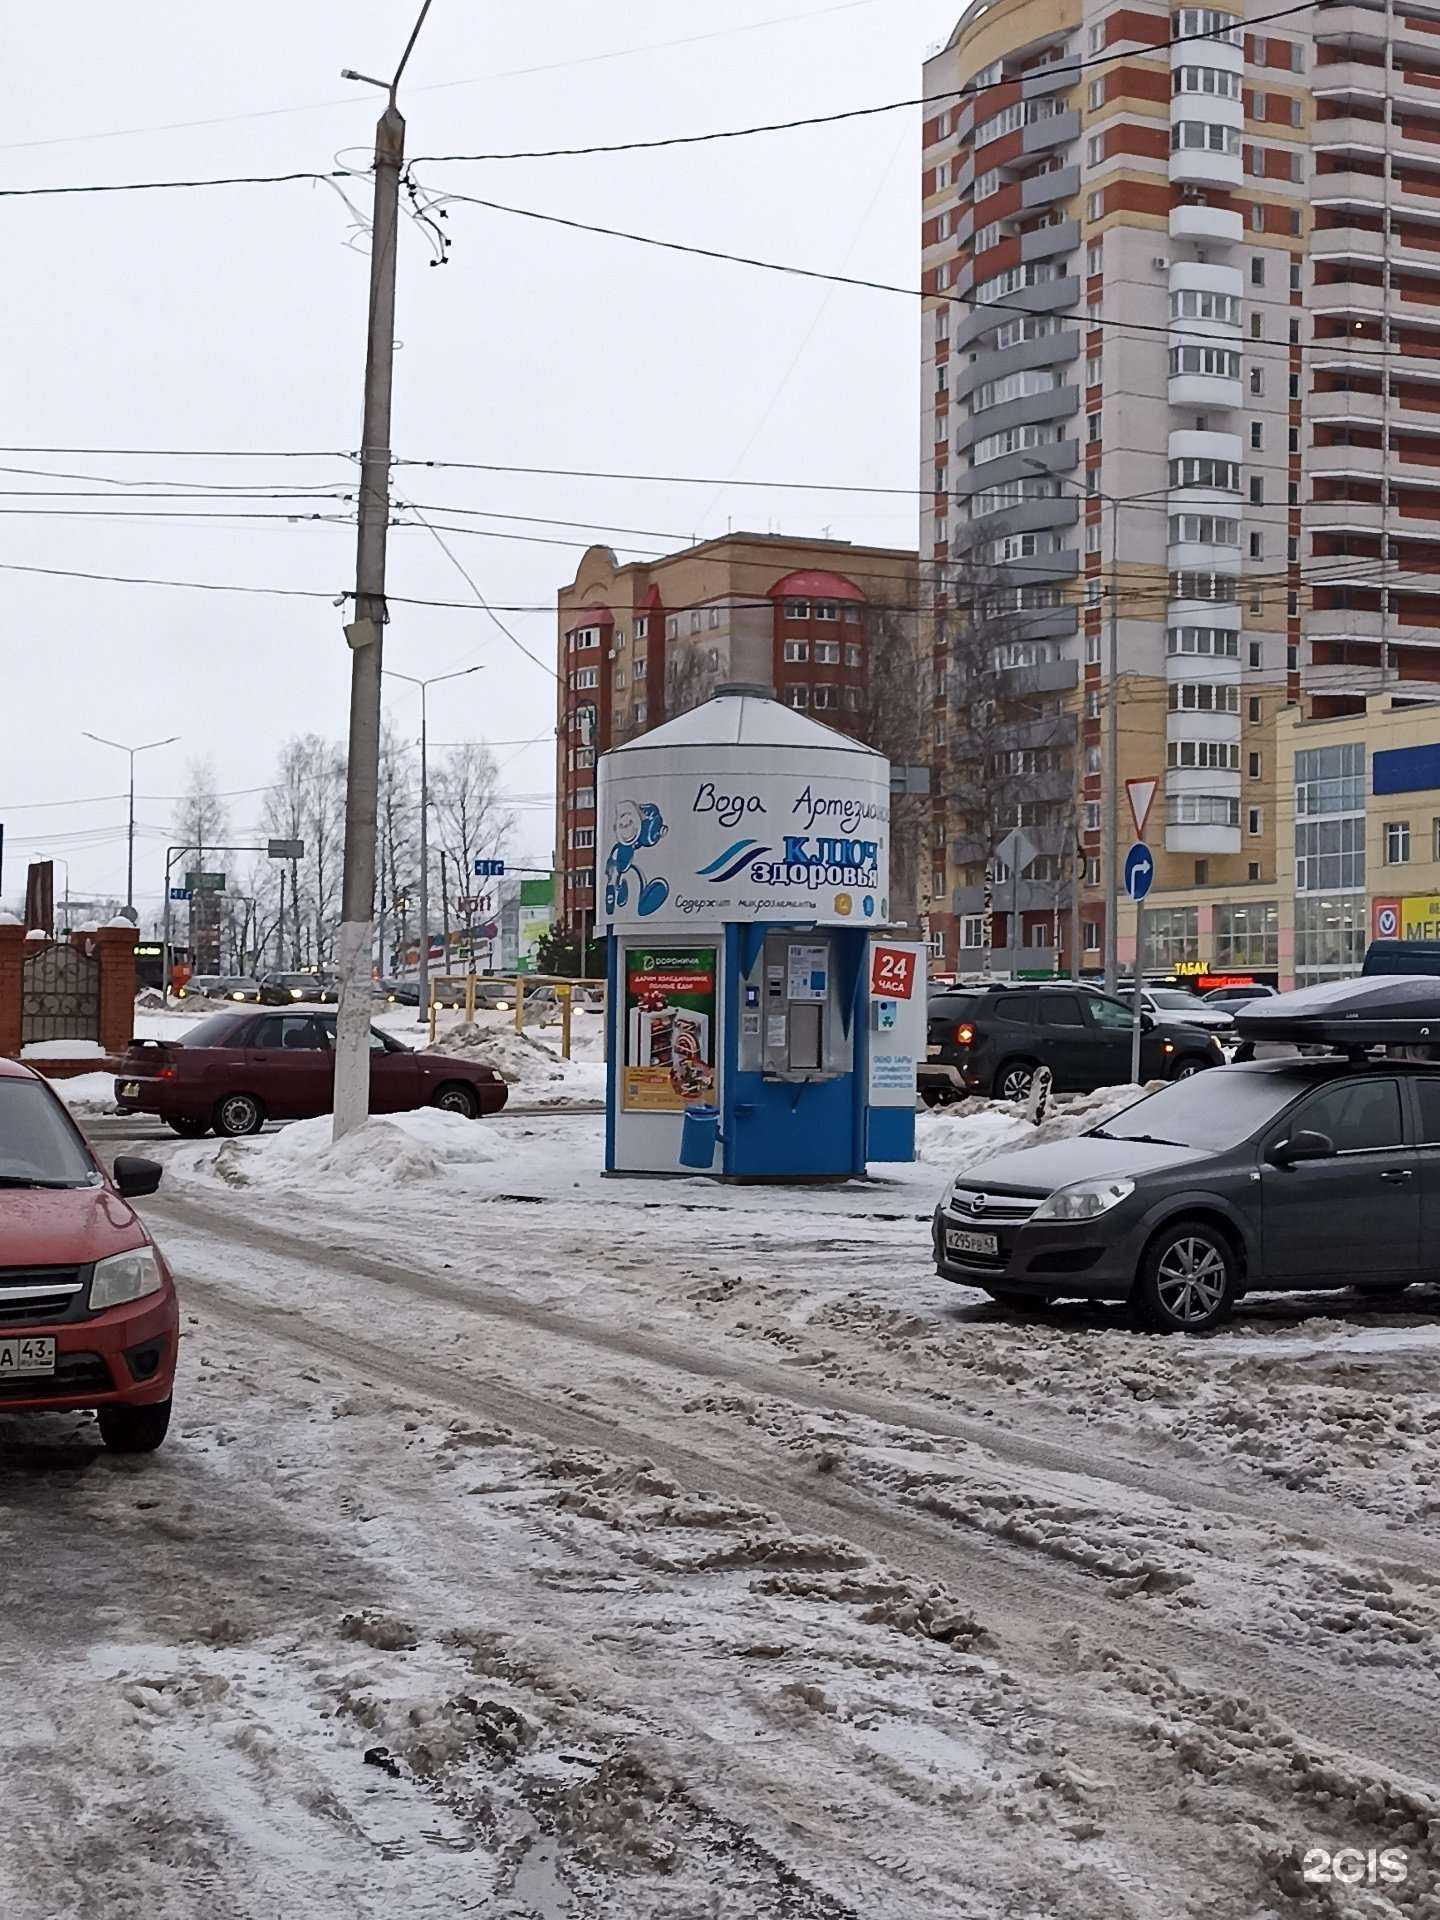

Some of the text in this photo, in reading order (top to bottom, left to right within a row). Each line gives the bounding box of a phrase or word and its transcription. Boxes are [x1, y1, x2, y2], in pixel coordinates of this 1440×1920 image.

[693, 783, 767, 827] Вода
[783, 836, 878, 867] КЛЮЧ
[880, 956, 907, 979] 24
[1174, 961, 1209, 976] ТАБАК
[879, 980, 905, 993] ЧАСА
[21, 1340, 46, 1359] 43
